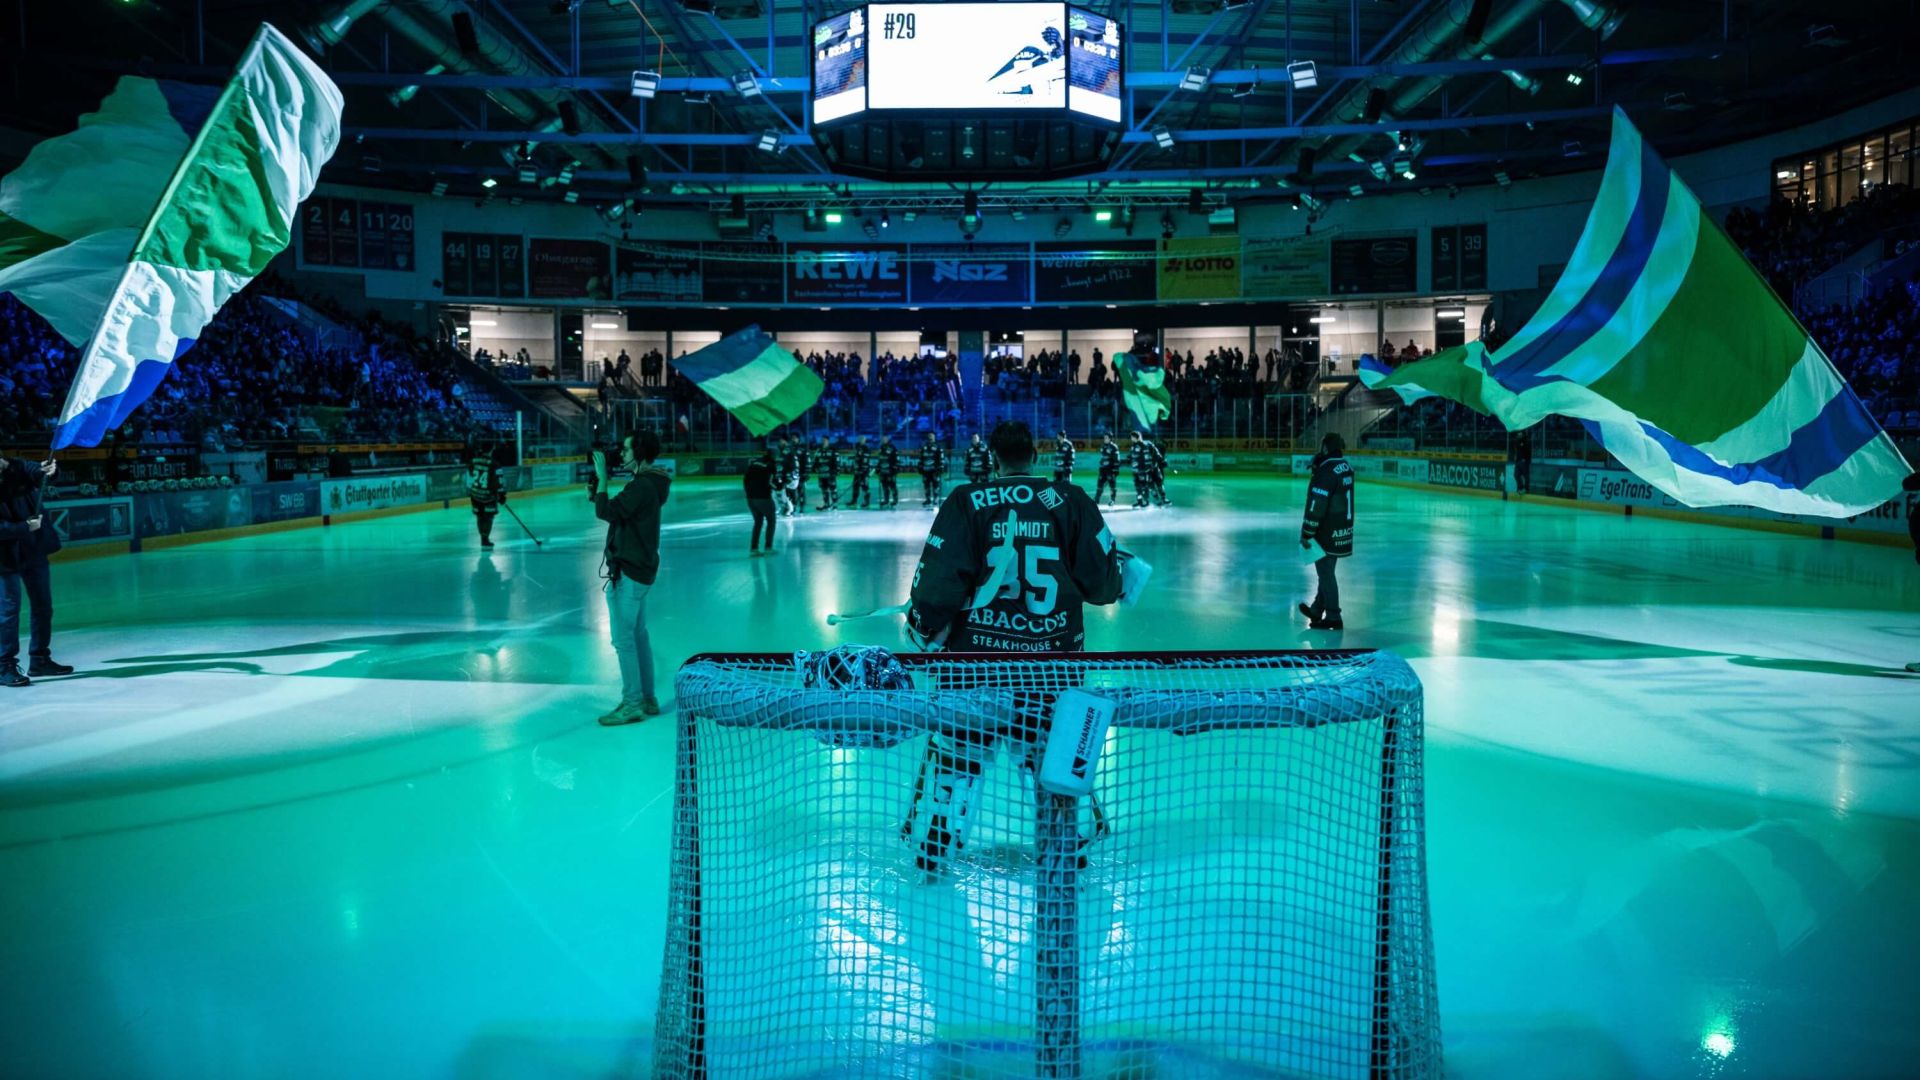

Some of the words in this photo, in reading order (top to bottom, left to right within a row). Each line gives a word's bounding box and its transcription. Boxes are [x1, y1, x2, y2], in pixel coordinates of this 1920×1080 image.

[883, 13, 916, 39] #29
[310, 206, 322, 224] 2
[340, 208, 351, 226] 4
[364, 211, 384, 229] 11
[390, 214, 413, 232] 20
[446, 242, 466, 259] 44
[1441, 238, 1449, 252] 5
[1465, 235, 1482, 250] 39
[502, 244, 519, 260] 27
[796, 250, 899, 280] REWE
[1185, 257, 1235, 272] LOTTO
[147, 463, 187, 478] TALENTE
[1429, 463, 1479, 487] ABACCO'S
[345, 484, 390, 506] Stuttgarter
[970, 485, 1033, 510] REKO
[1600, 476, 1654, 501] EgeTrans
[972, 635, 1051, 652] STEAKHOUSE
[1077, 706, 1096, 756] SCHANNER
